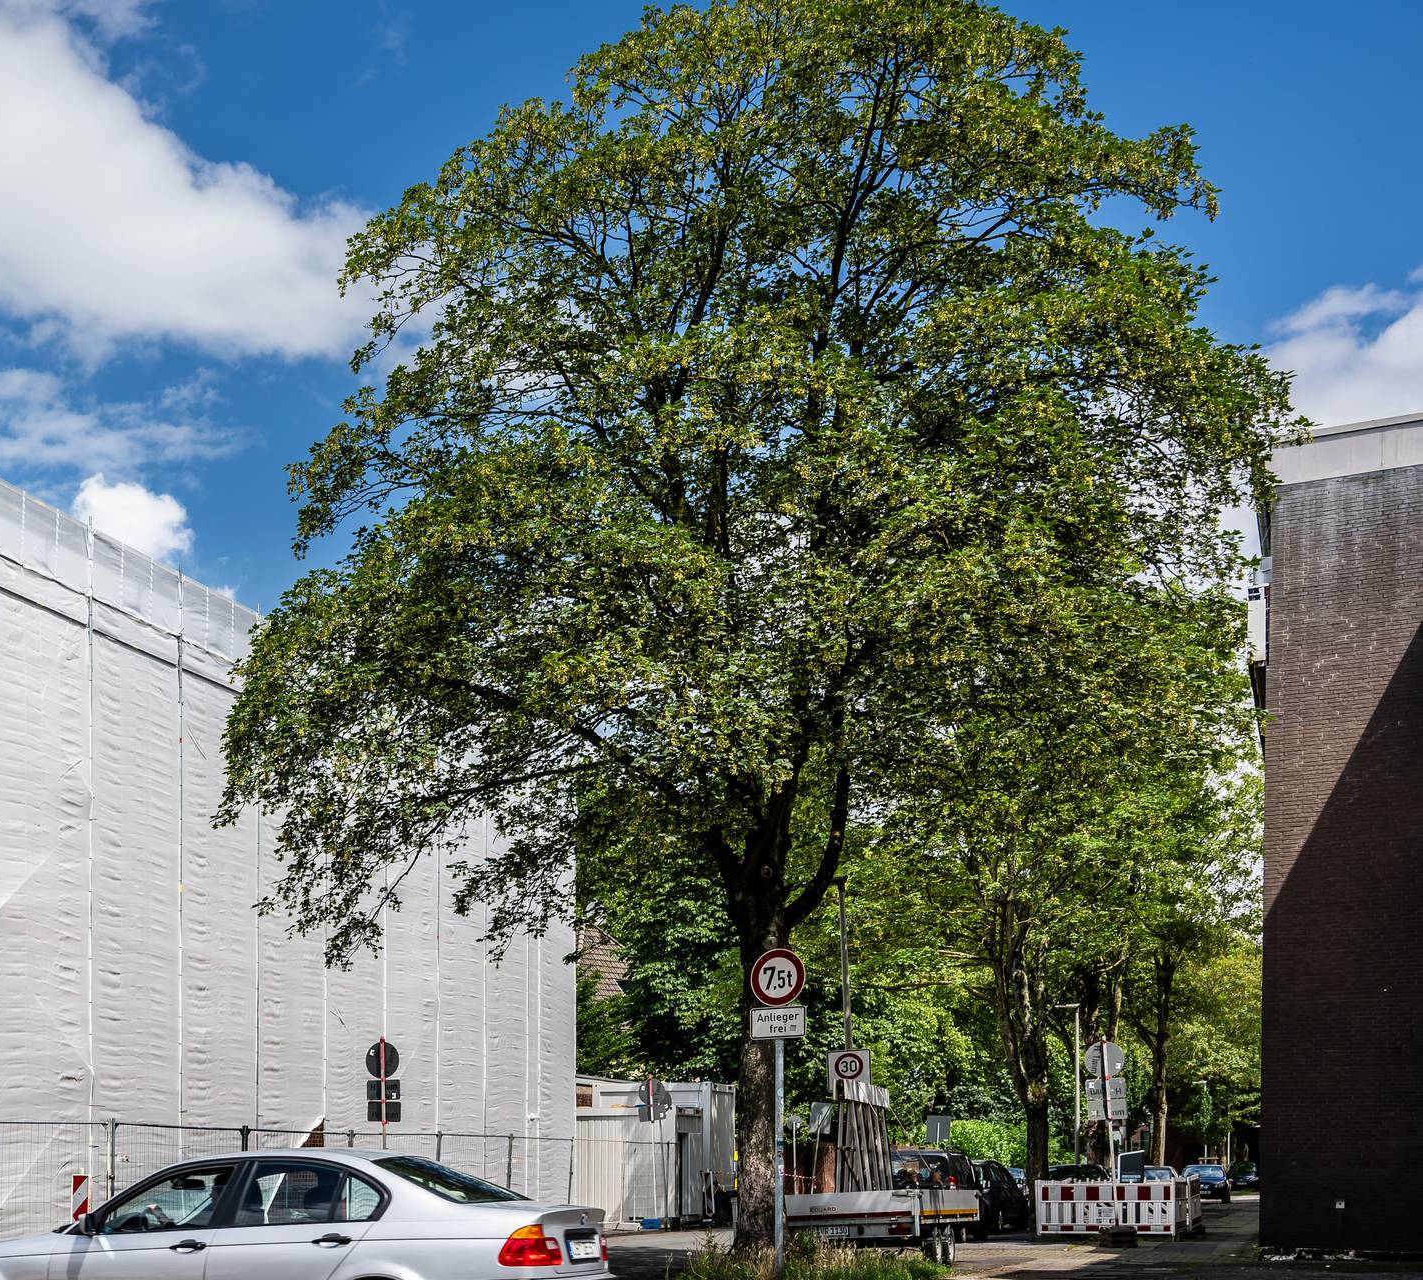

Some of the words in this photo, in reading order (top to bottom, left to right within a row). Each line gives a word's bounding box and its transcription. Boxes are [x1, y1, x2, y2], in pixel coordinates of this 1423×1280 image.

[763, 966, 793, 990] 7,5t
[757, 1012, 799, 1023] Anlieger
[769, 1024, 787, 1033] frei
[840, 1060, 857, 1073] 30
